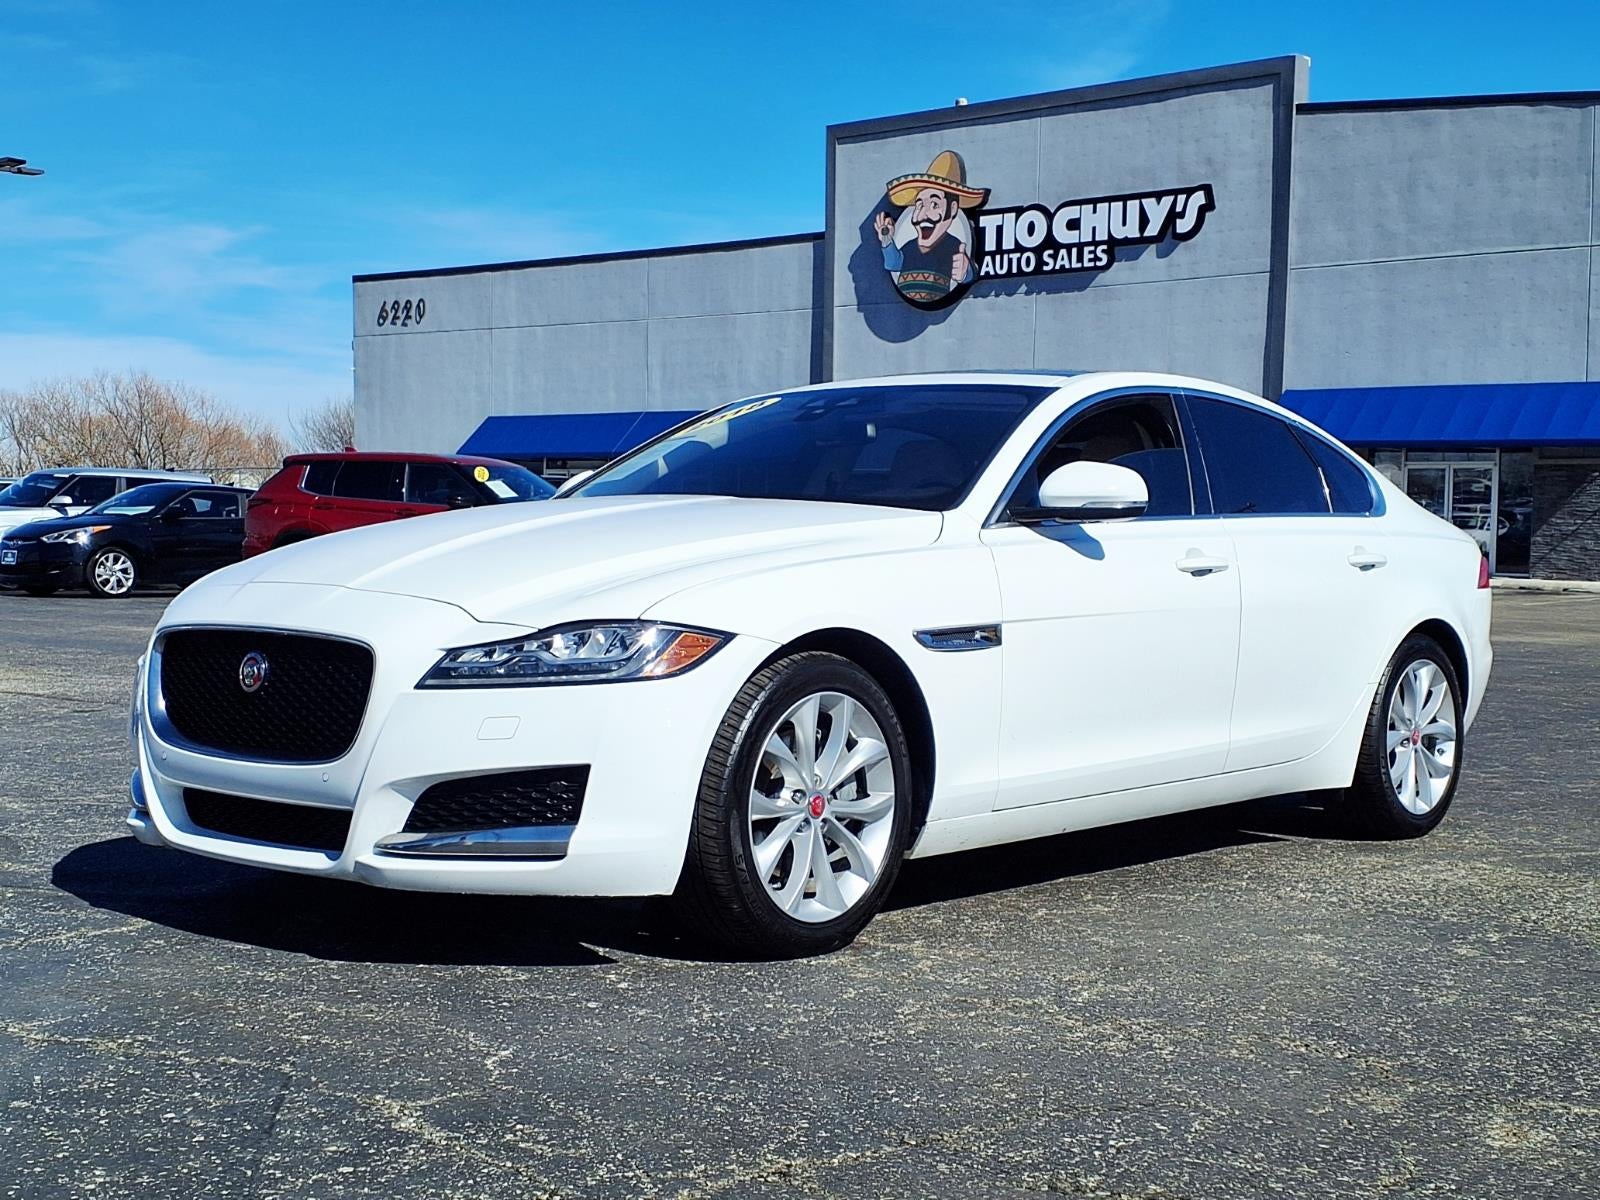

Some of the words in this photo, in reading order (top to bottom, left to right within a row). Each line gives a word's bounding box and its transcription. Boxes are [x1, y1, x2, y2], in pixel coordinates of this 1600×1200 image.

[979, 209, 1048, 252] TIO
[980, 251, 1036, 276] AUTO
[1042, 245, 1108, 271] SALES
[377, 298, 426, 327] 6220
